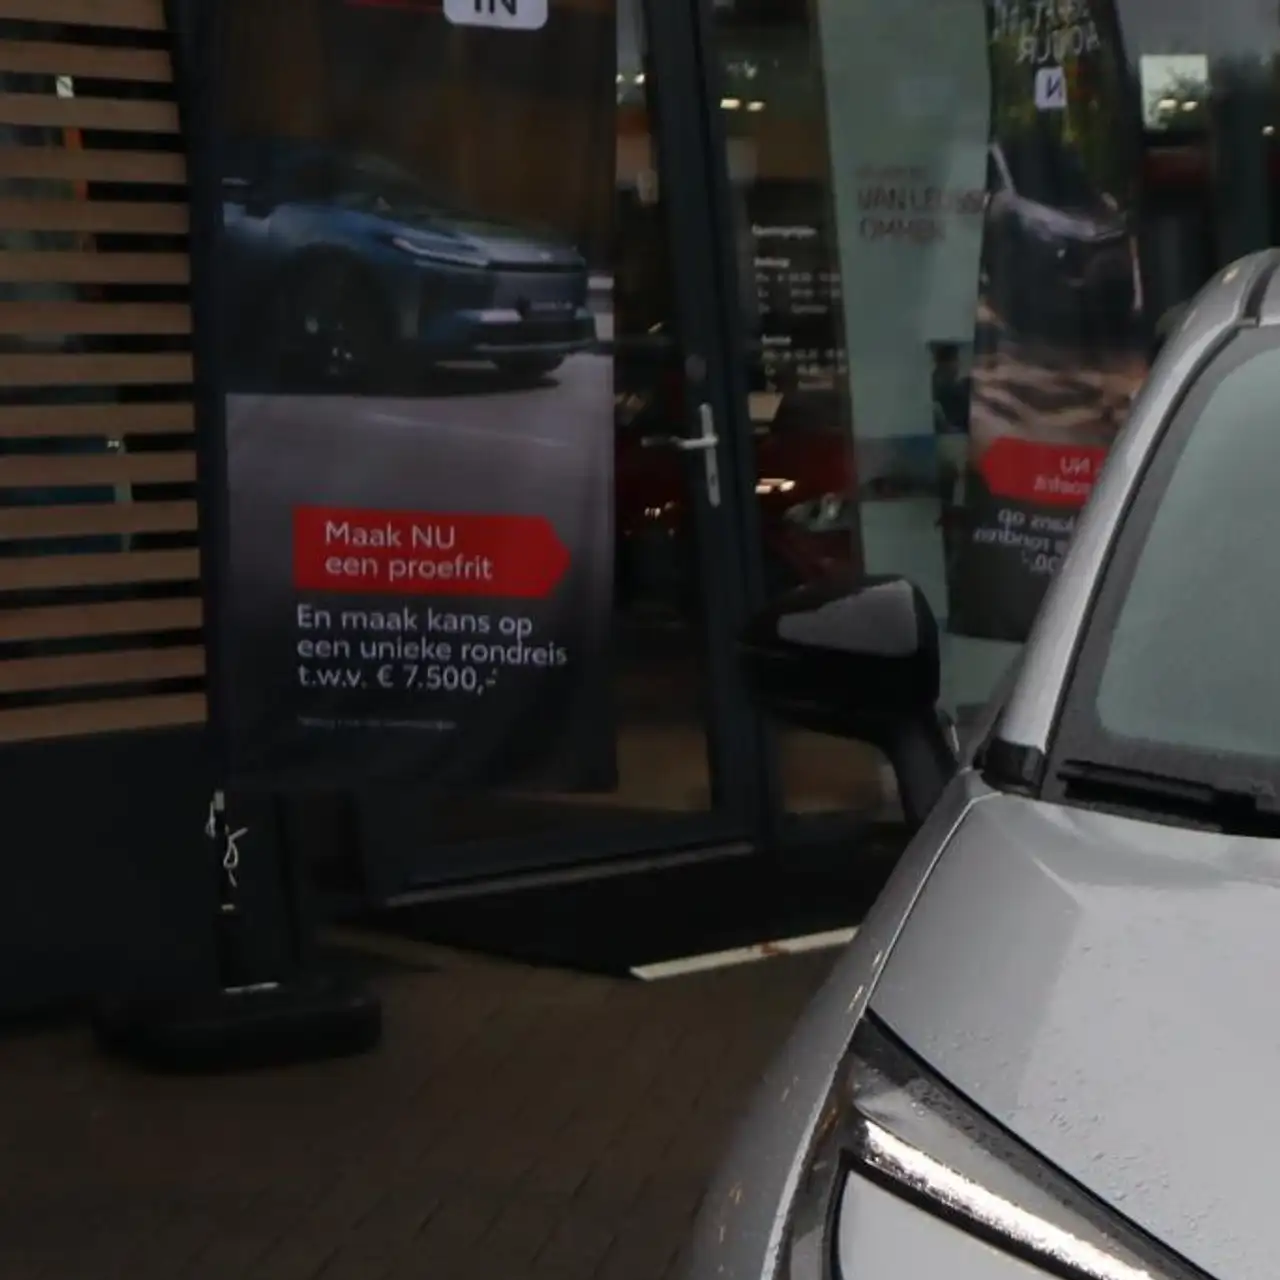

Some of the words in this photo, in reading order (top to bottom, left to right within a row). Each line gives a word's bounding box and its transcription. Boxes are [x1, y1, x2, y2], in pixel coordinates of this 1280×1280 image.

[325, 520, 402, 548] Maak
[412, 525, 455, 549] NU
[325, 556, 378, 577] een
[389, 553, 494, 582] proefrit
[297, 604, 331, 629] En
[341, 606, 417, 631] maak
[427, 607, 490, 633] kans
[498, 616, 532, 639] op
[297, 639, 350, 658] een
[360, 636, 451, 661] unieke
[461, 641, 568, 665] rondreis
[297, 664, 367, 688] t.w.v.
[376, 664, 394, 687] €
